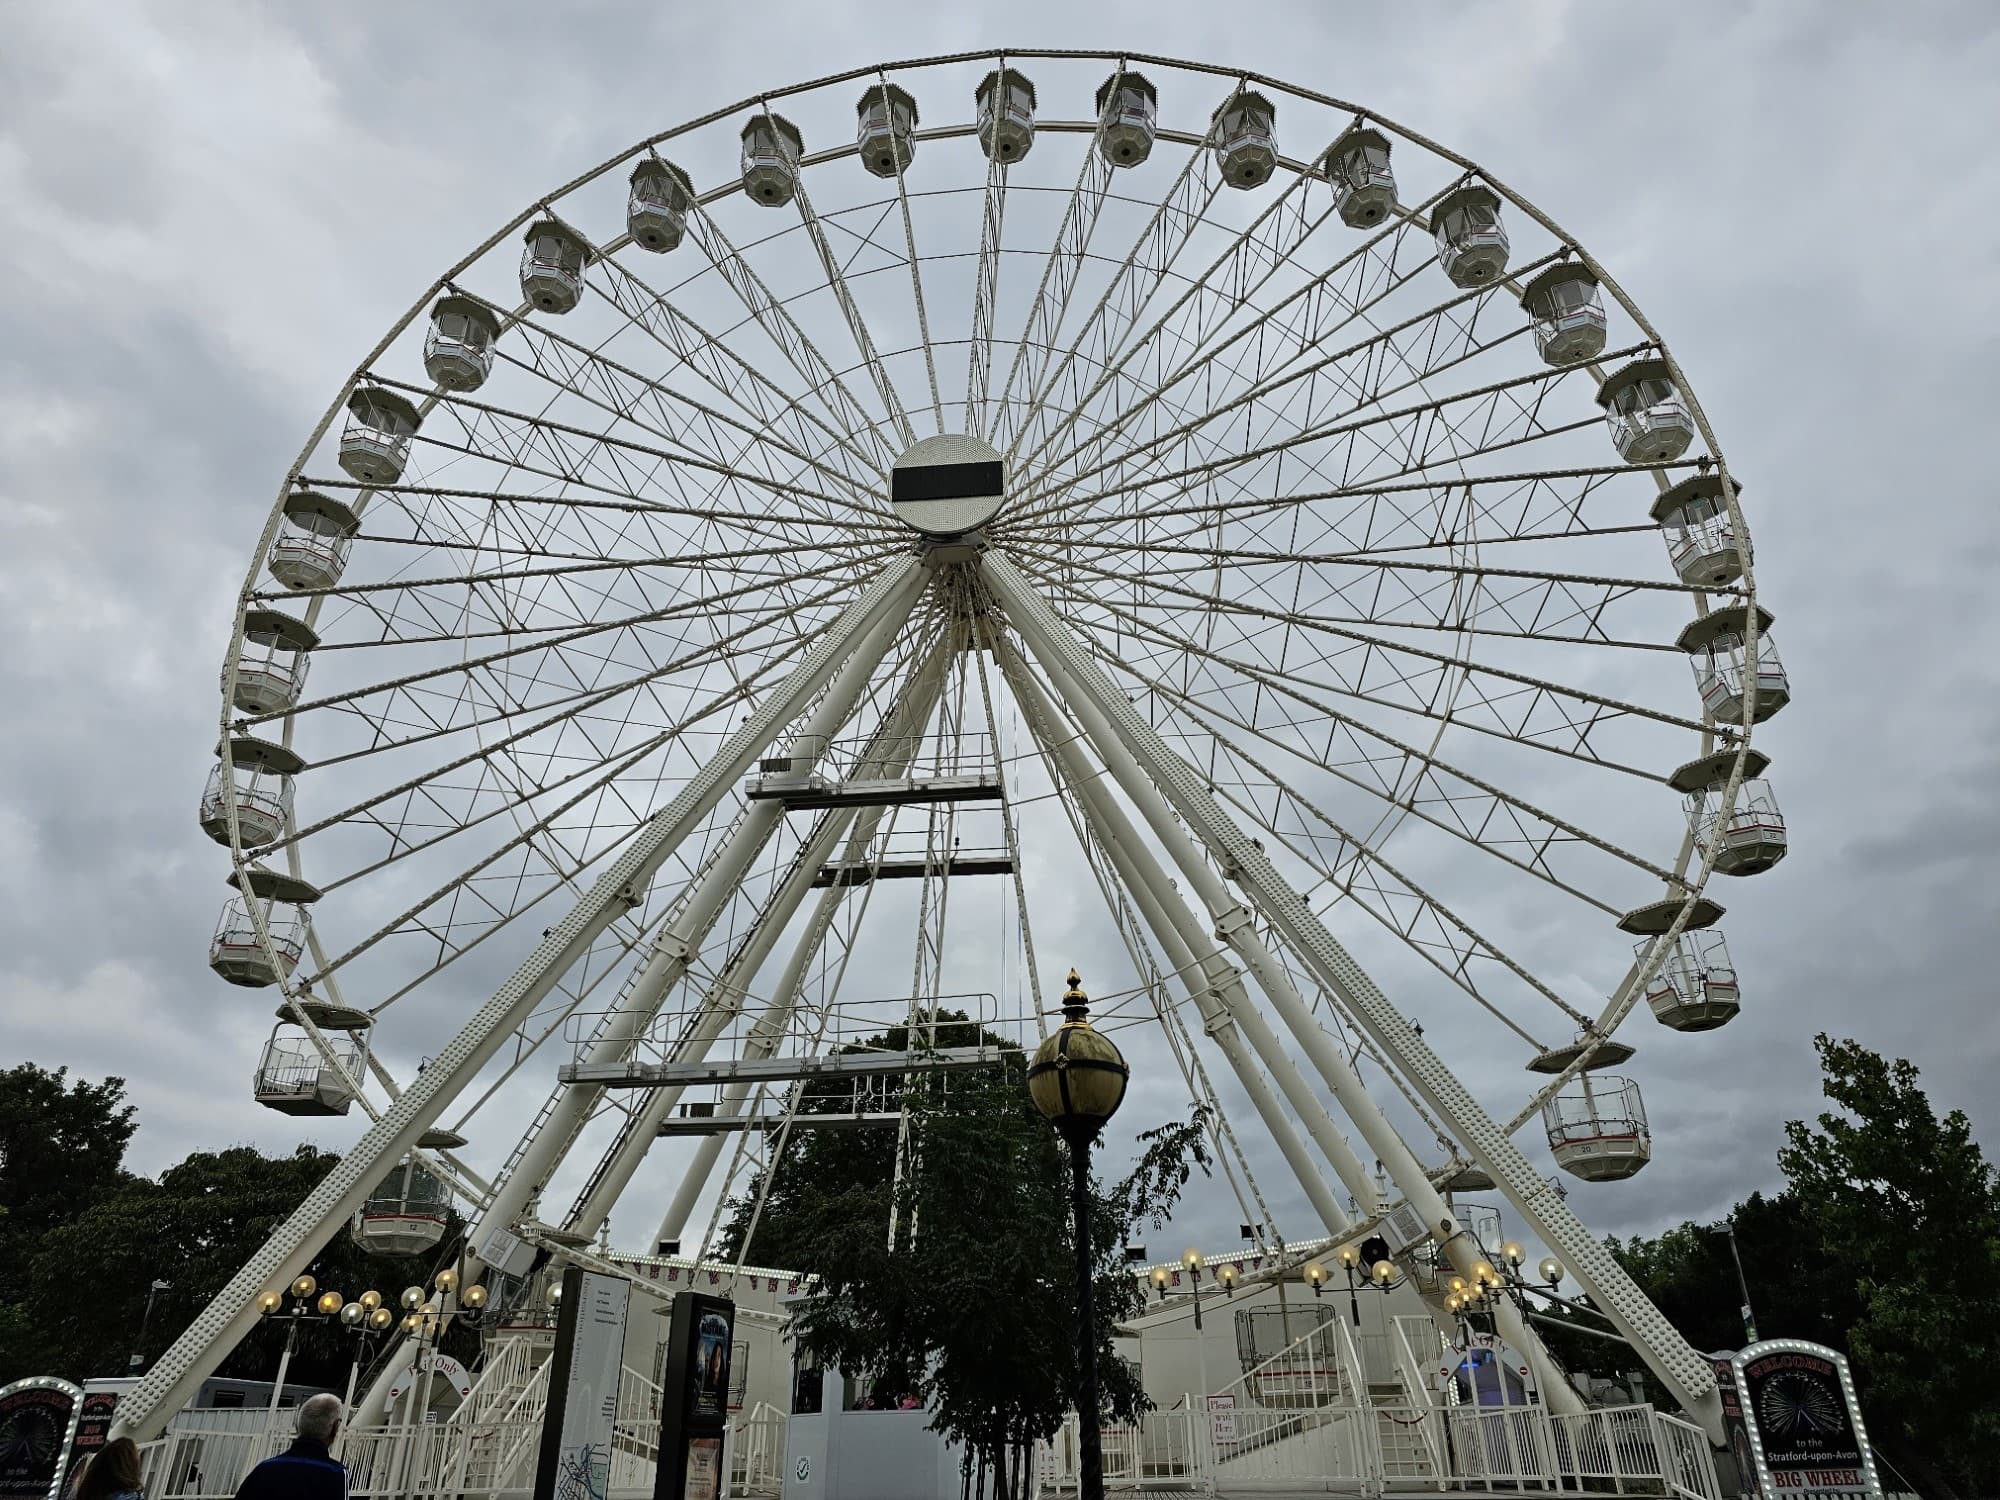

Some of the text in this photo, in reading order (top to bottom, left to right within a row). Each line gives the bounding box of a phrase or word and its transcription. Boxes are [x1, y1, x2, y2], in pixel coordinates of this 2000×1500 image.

[436, 1357, 460, 1375] Only
[1748, 1355, 1833, 1377] WELCOME
[1796, 1438, 1823, 1447] to the
[1768, 1451, 1858, 1463] Stratford-upon-Avon
[1773, 1469, 1865, 1488] BIG WHEEL
